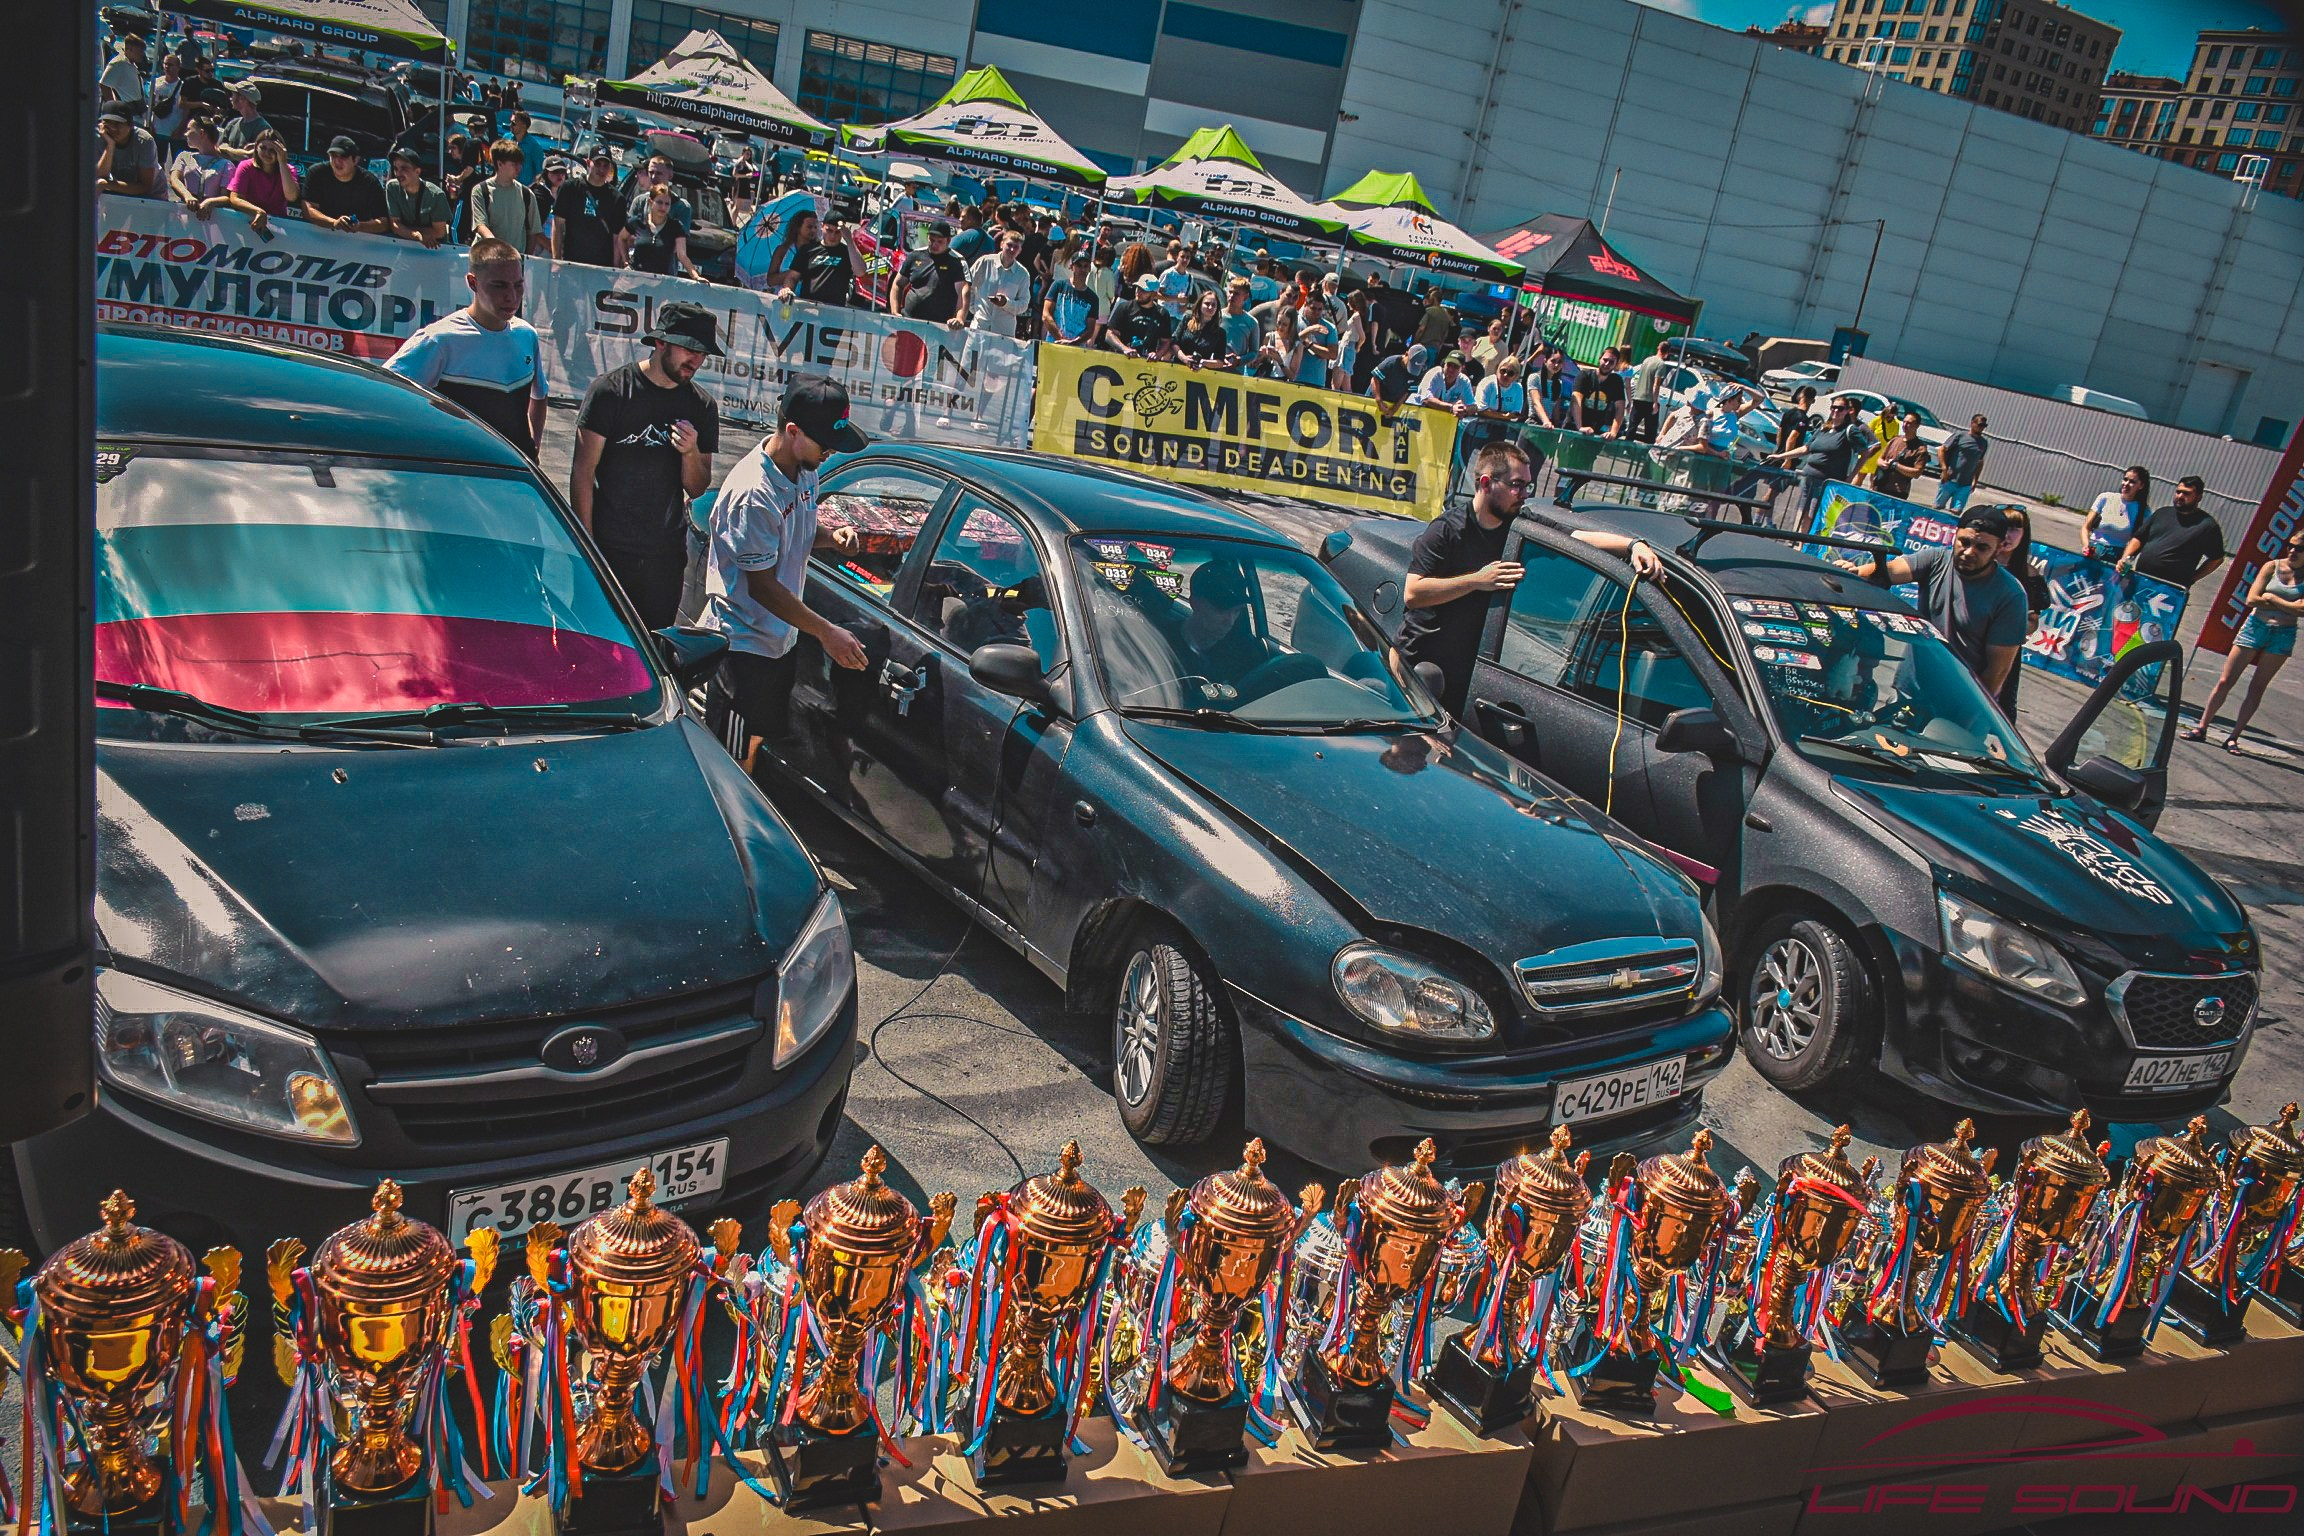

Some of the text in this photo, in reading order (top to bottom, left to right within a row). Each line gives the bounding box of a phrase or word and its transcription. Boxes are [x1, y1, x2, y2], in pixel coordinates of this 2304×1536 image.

[234, 8, 379, 43] ALPHARD GROUP
[646, 91, 793, 136] http://en.alphardaudio.ru
[946, 146, 1058, 175] ALPHARD GROUP
[1201, 201, 1299, 228] ALPHARD GROUP
[1392, 248, 1480, 273] СПАРТА МАРКЕТ
[1090, 430, 1407, 495] SOUND DEADENING
[1909, 517, 1957, 545] АВТ
[1101, 544, 1122, 555] 046
[1146, 548, 1167, 559] 034
[1105, 568, 1127, 579] 033
[1155, 576, 1176, 587] 039
[2221, 561, 2259, 630] LIFE
[1652, 1062, 1680, 1089] 142
[2203, 1054, 2226, 1072] 142
[1656, 1088, 1670, 1099] RUS
[656, 1146, 716, 1186] 154
[666, 1180, 697, 1198] RUS
